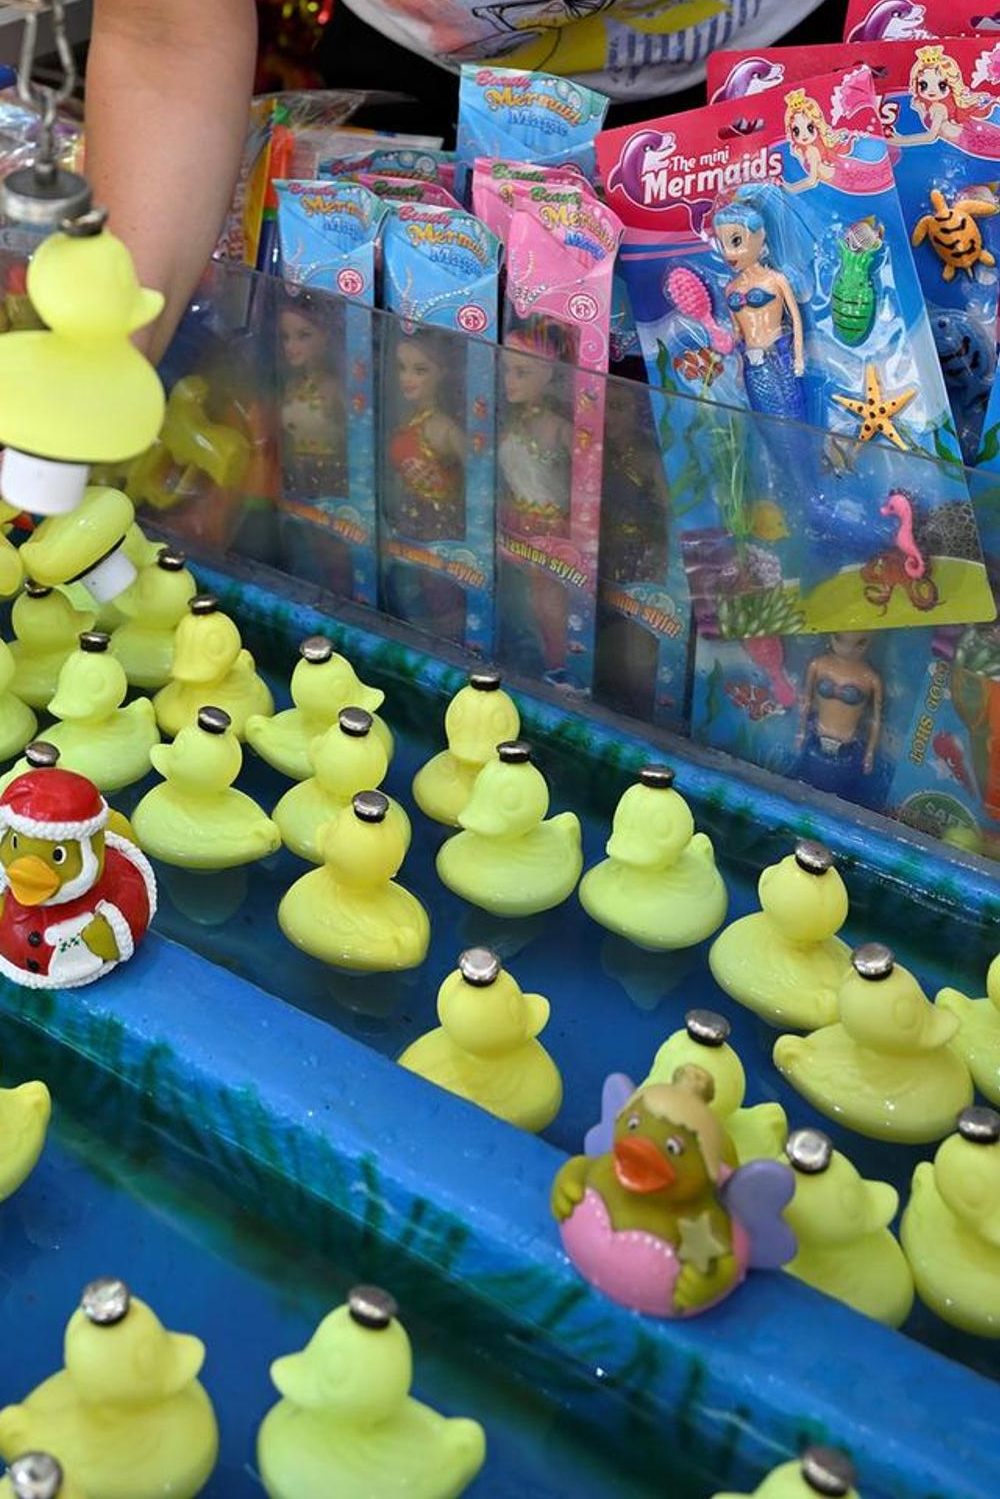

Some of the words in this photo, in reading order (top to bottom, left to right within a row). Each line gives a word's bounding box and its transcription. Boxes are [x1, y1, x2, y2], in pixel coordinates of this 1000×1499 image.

[669, 155, 696, 173] The
[699, 146, 730, 167] mini
[641, 146, 783, 206] Mermaids
[548, 557, 589, 589] style!
